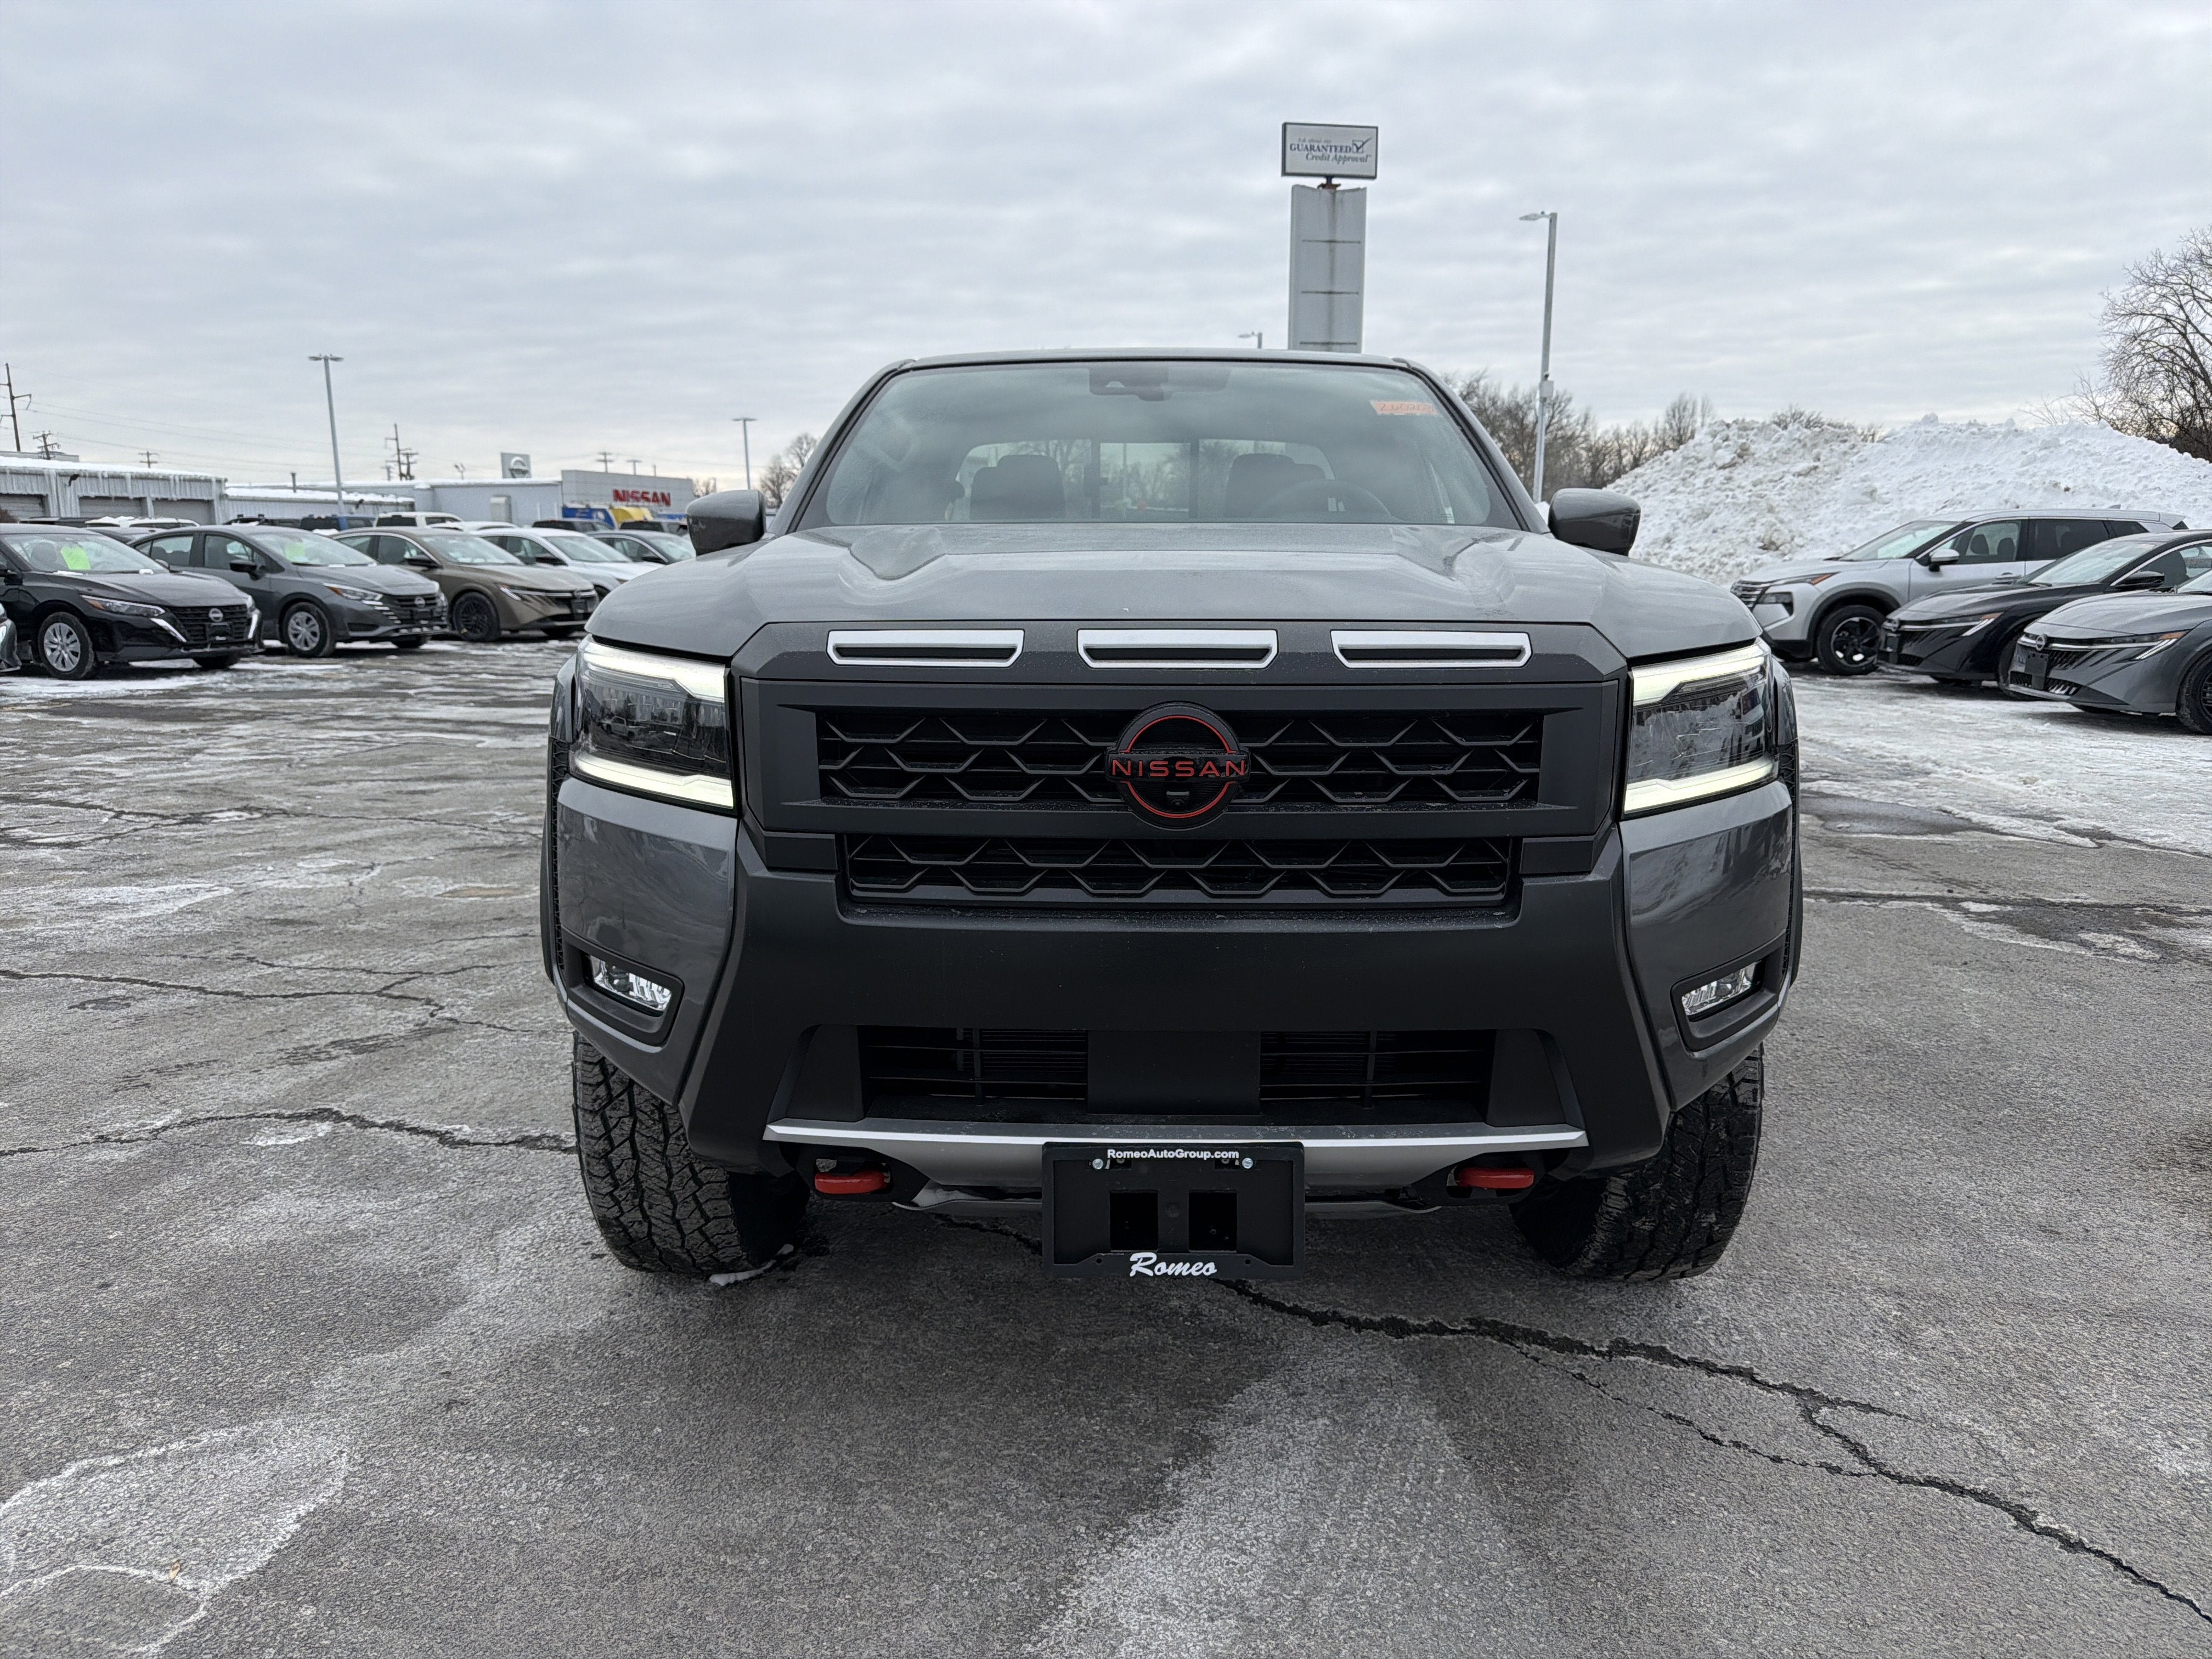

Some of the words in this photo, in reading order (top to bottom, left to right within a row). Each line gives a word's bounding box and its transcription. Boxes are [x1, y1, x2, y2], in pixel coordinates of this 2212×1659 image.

[1289, 143, 1352, 154] GUARANTEED
[1305, 152, 1330, 161] Credit
[1331, 153, 1369, 165] Approval
[613, 489, 671, 507] NISSAN
[1111, 759, 1246, 777] NISSAN
[1107, 1149, 1239, 1160] RomeoAutoGroup.com
[1130, 1252, 1217, 1277] Romeo
